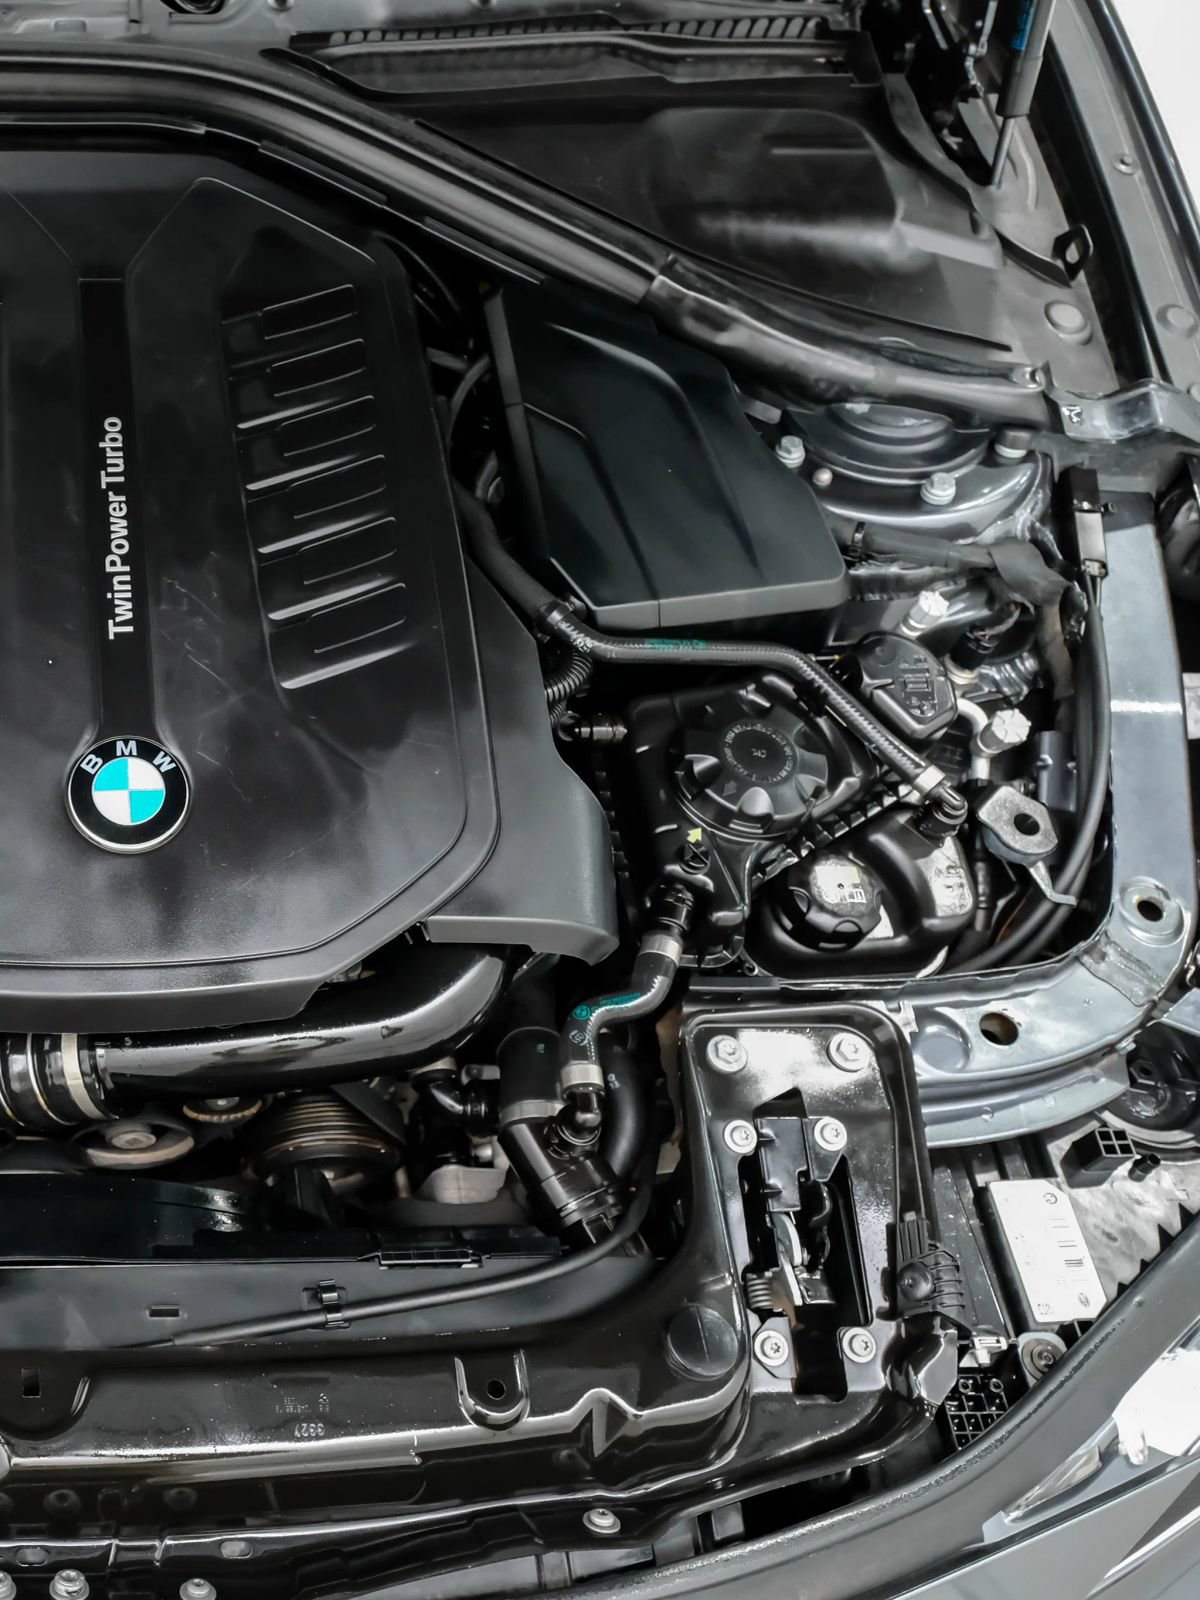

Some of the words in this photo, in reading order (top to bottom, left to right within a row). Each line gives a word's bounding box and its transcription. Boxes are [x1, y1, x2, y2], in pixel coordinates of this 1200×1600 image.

[99, 416, 126, 489] Turbo
[105, 491, 134, 640] TwinPower
[80, 740, 176, 775] BMW
